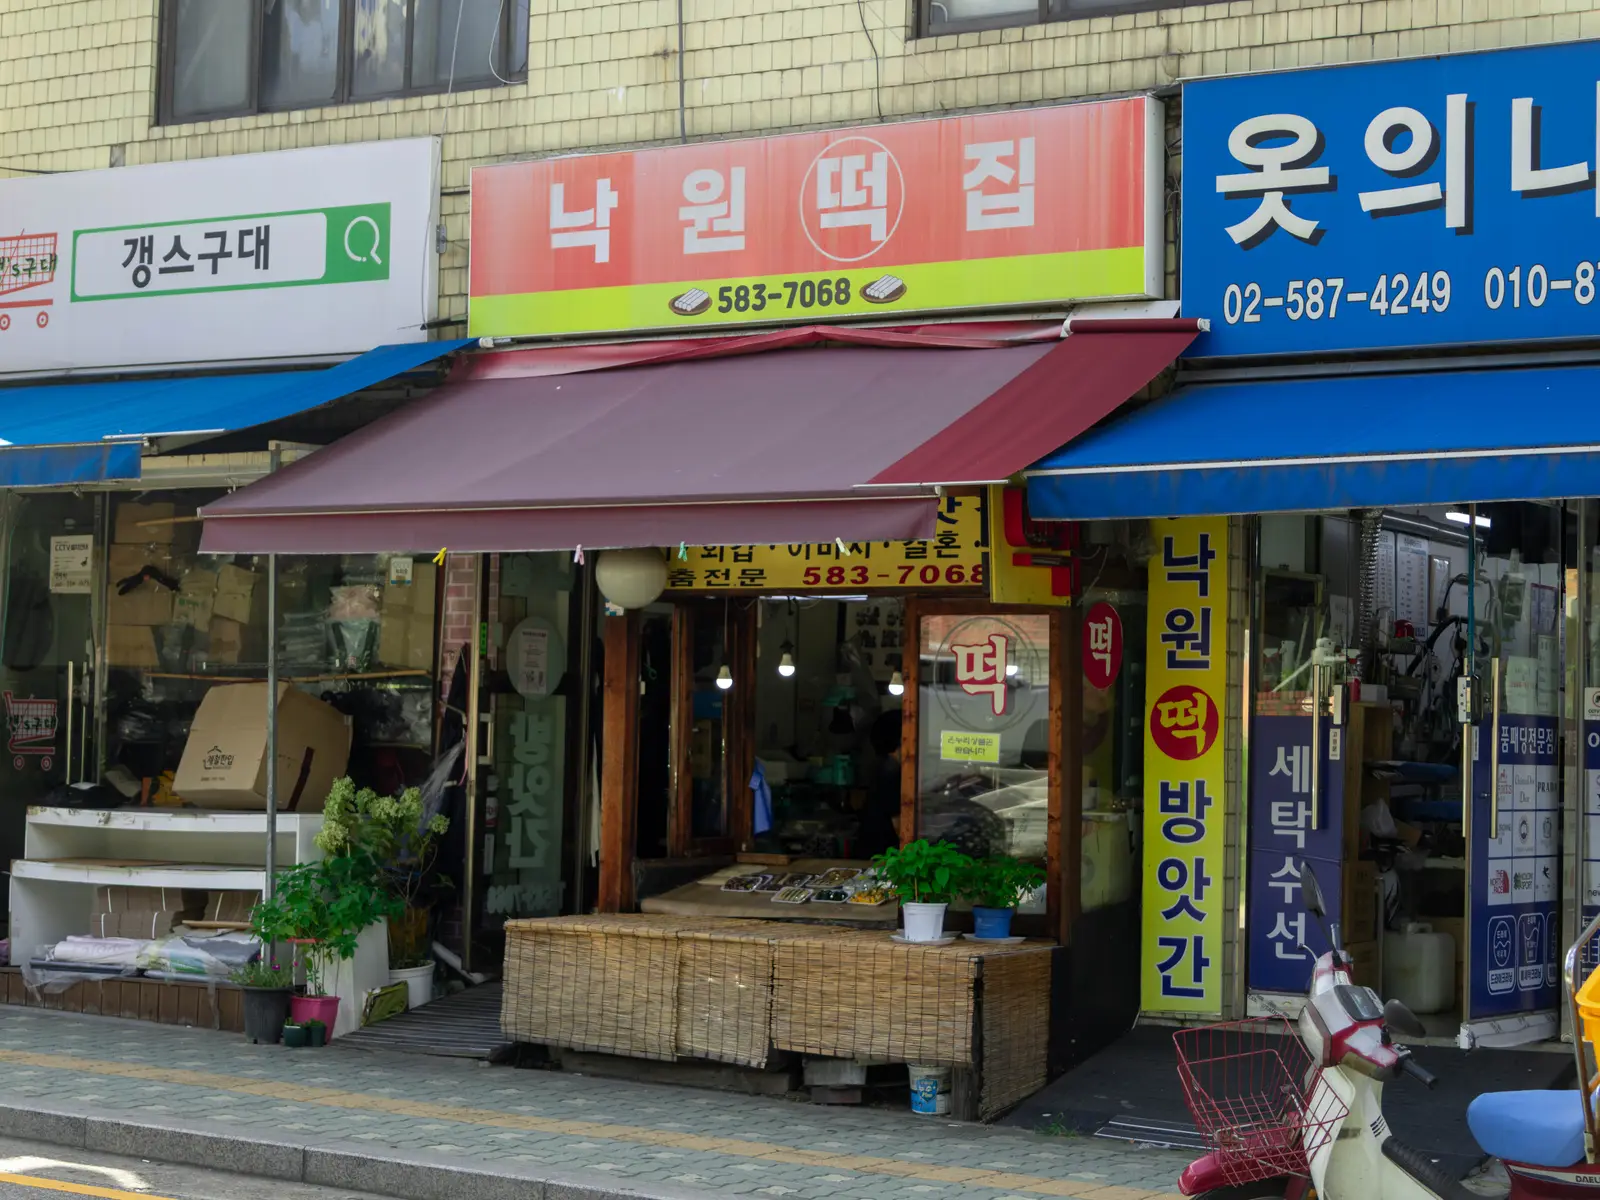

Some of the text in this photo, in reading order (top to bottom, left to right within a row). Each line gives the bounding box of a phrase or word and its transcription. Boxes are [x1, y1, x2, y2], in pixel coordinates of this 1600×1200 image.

[121, 224, 270, 288] 갱스구대
[717, 277, 851, 314] 583-7068
[1222, 269, 1451, 325] 02-587-4249
[951, 634, 1008, 716] 떡
[1089, 616, 1113, 677] 떡
